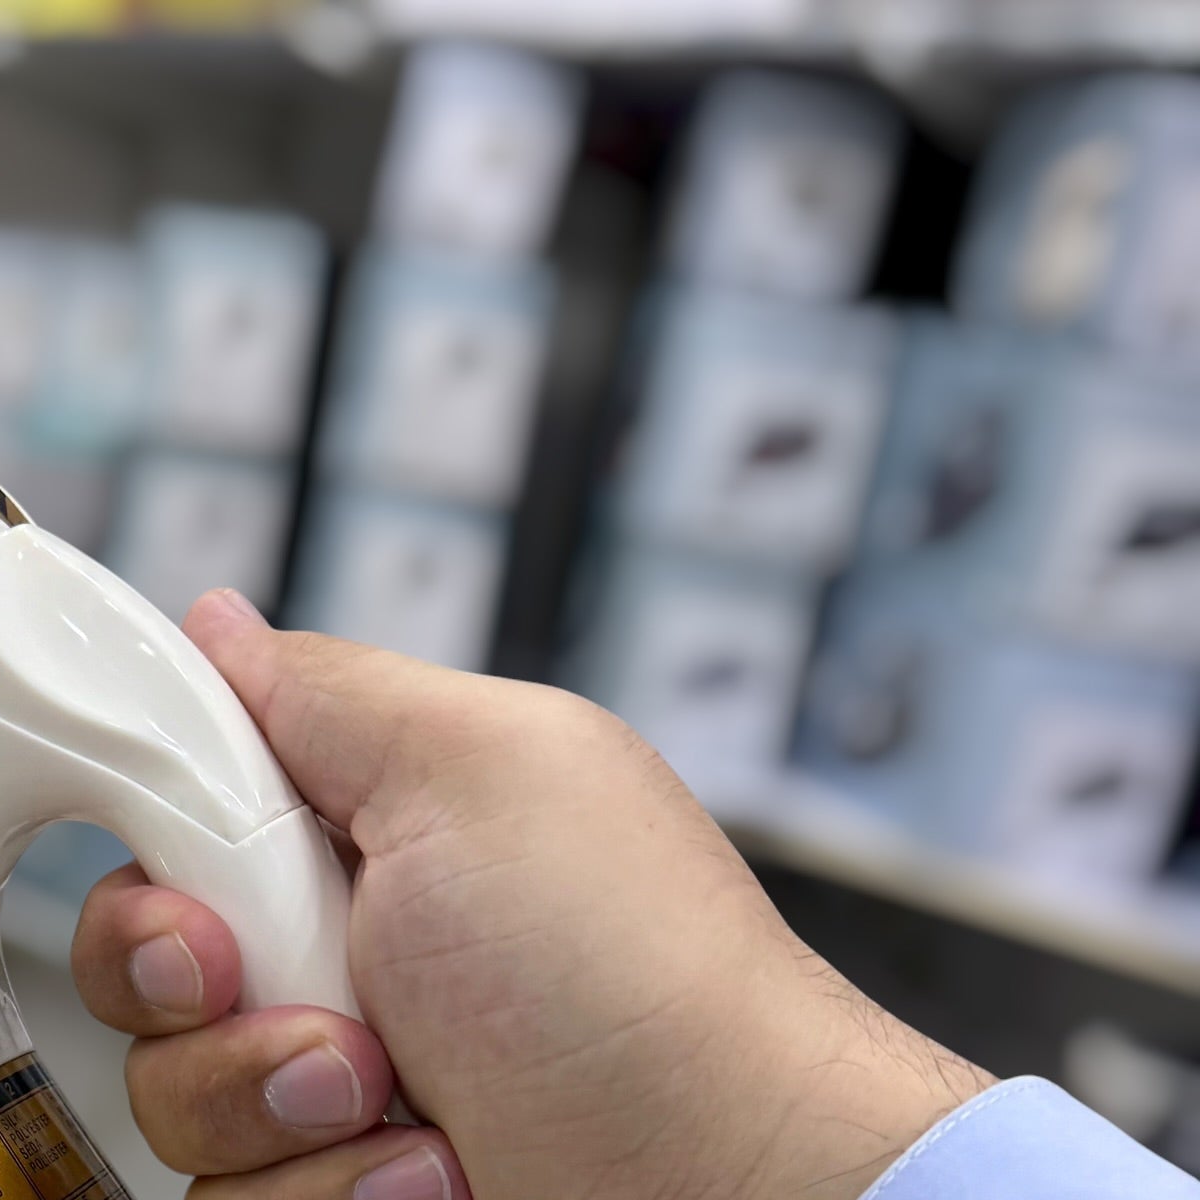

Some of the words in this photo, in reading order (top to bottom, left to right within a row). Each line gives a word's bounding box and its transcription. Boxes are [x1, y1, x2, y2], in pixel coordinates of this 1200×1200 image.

[4, 1081, 16, 1096] 2
[1, 1111, 19, 1130] SILK
[19, 1138, 43, 1159] SEDA
